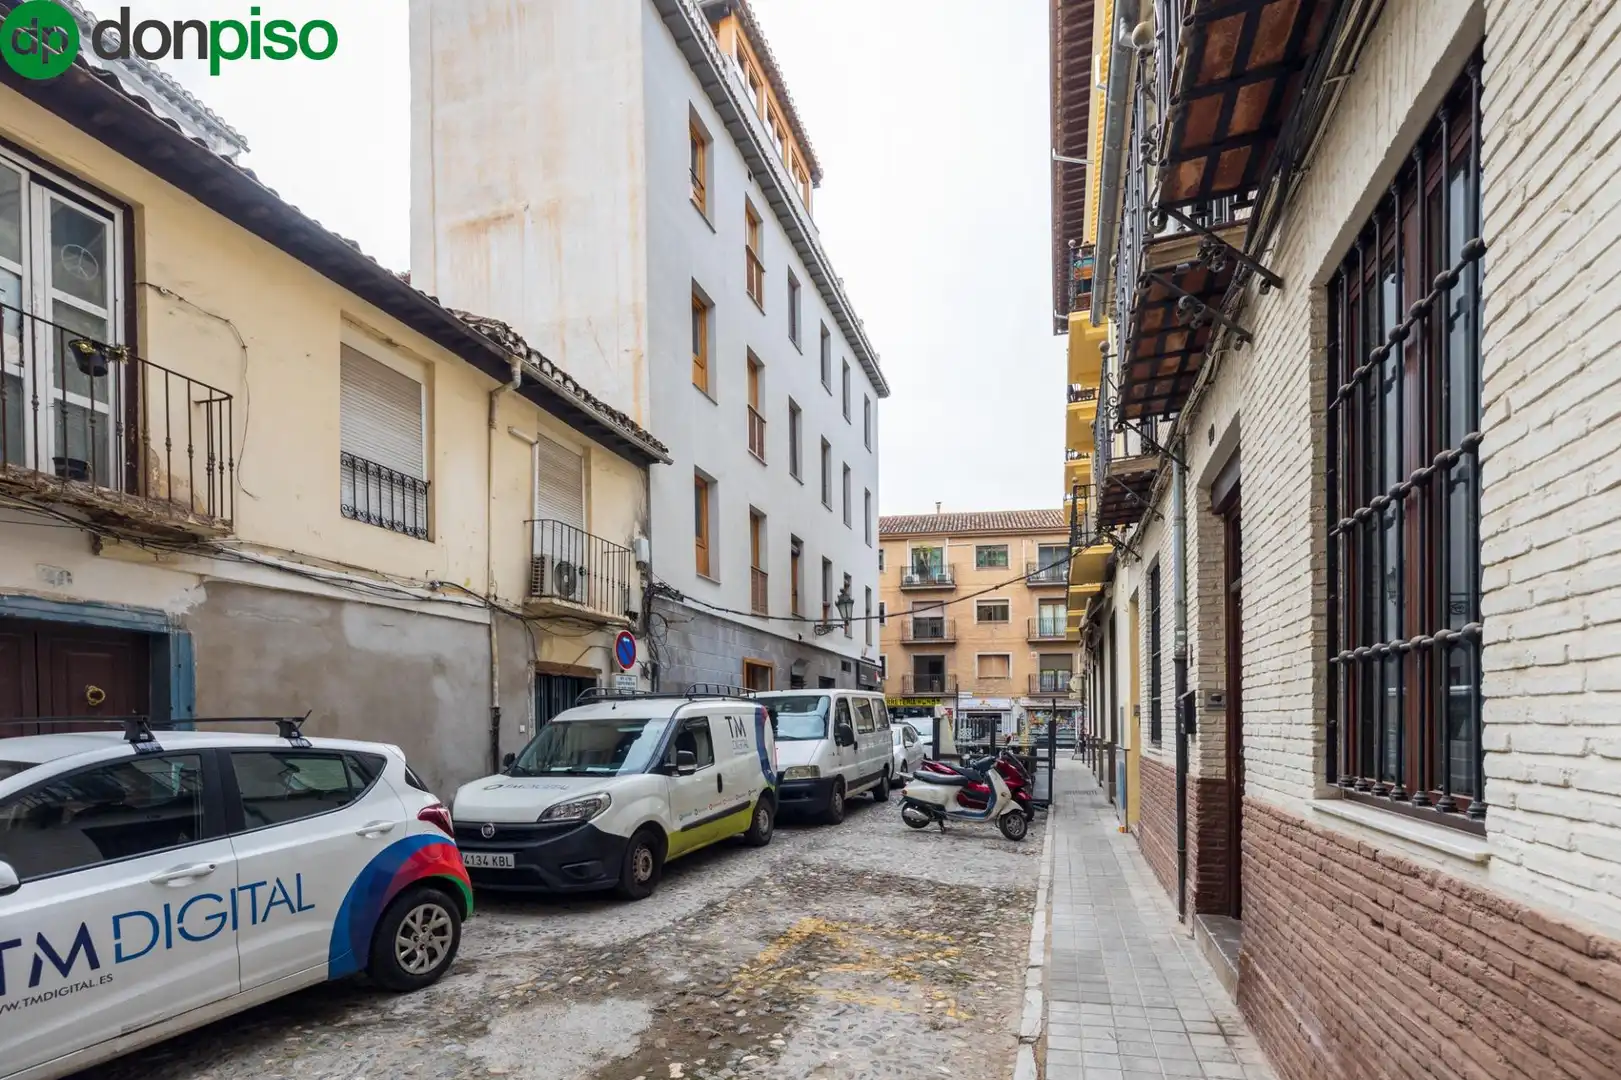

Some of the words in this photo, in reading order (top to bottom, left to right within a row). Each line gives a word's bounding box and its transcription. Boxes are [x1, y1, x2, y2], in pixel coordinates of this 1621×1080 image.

[724, 715, 747, 738] TM
[463, 854, 489, 866] 4134
[491, 855, 513, 867] KBL
[112, 872, 316, 965] DIGITAL
